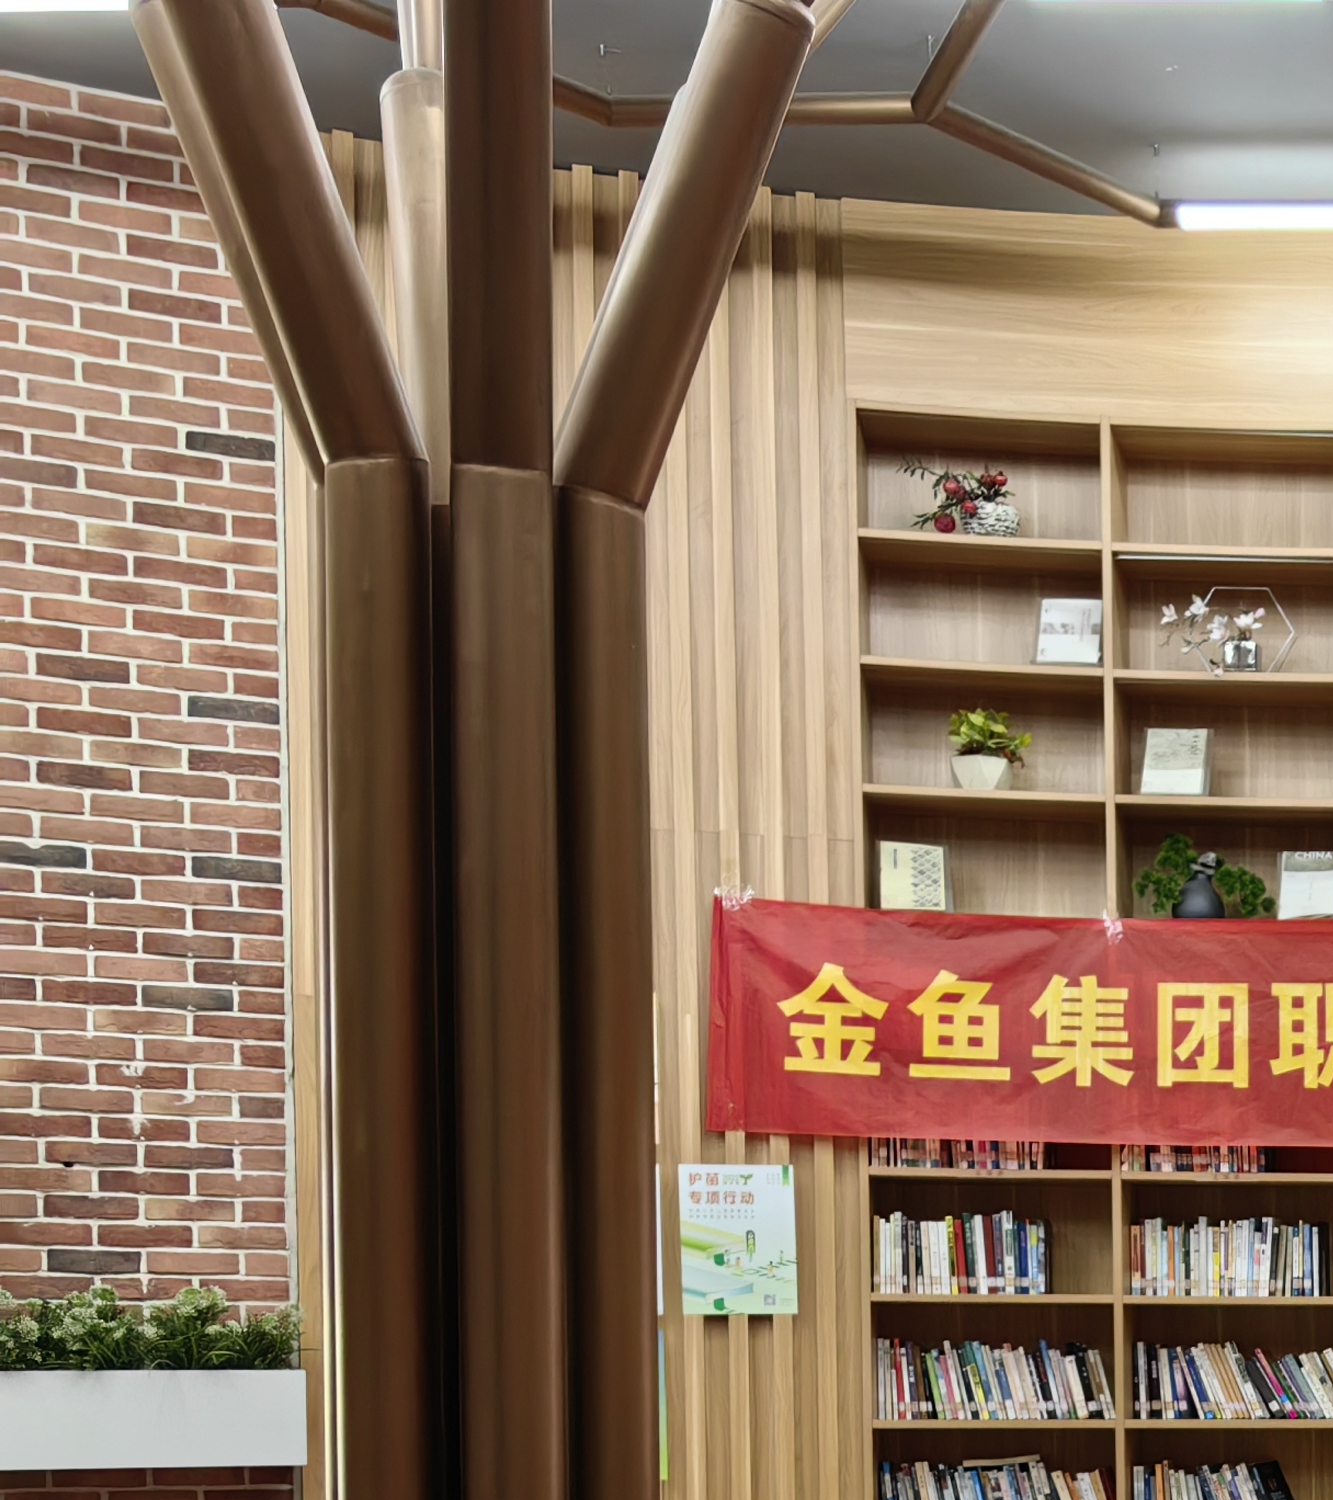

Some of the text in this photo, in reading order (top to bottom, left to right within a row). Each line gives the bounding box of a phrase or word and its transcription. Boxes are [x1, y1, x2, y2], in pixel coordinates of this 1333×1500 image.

[1294, 851, 1333, 860] CHINA
[688, 1190, 755, 1205] 专项行动
